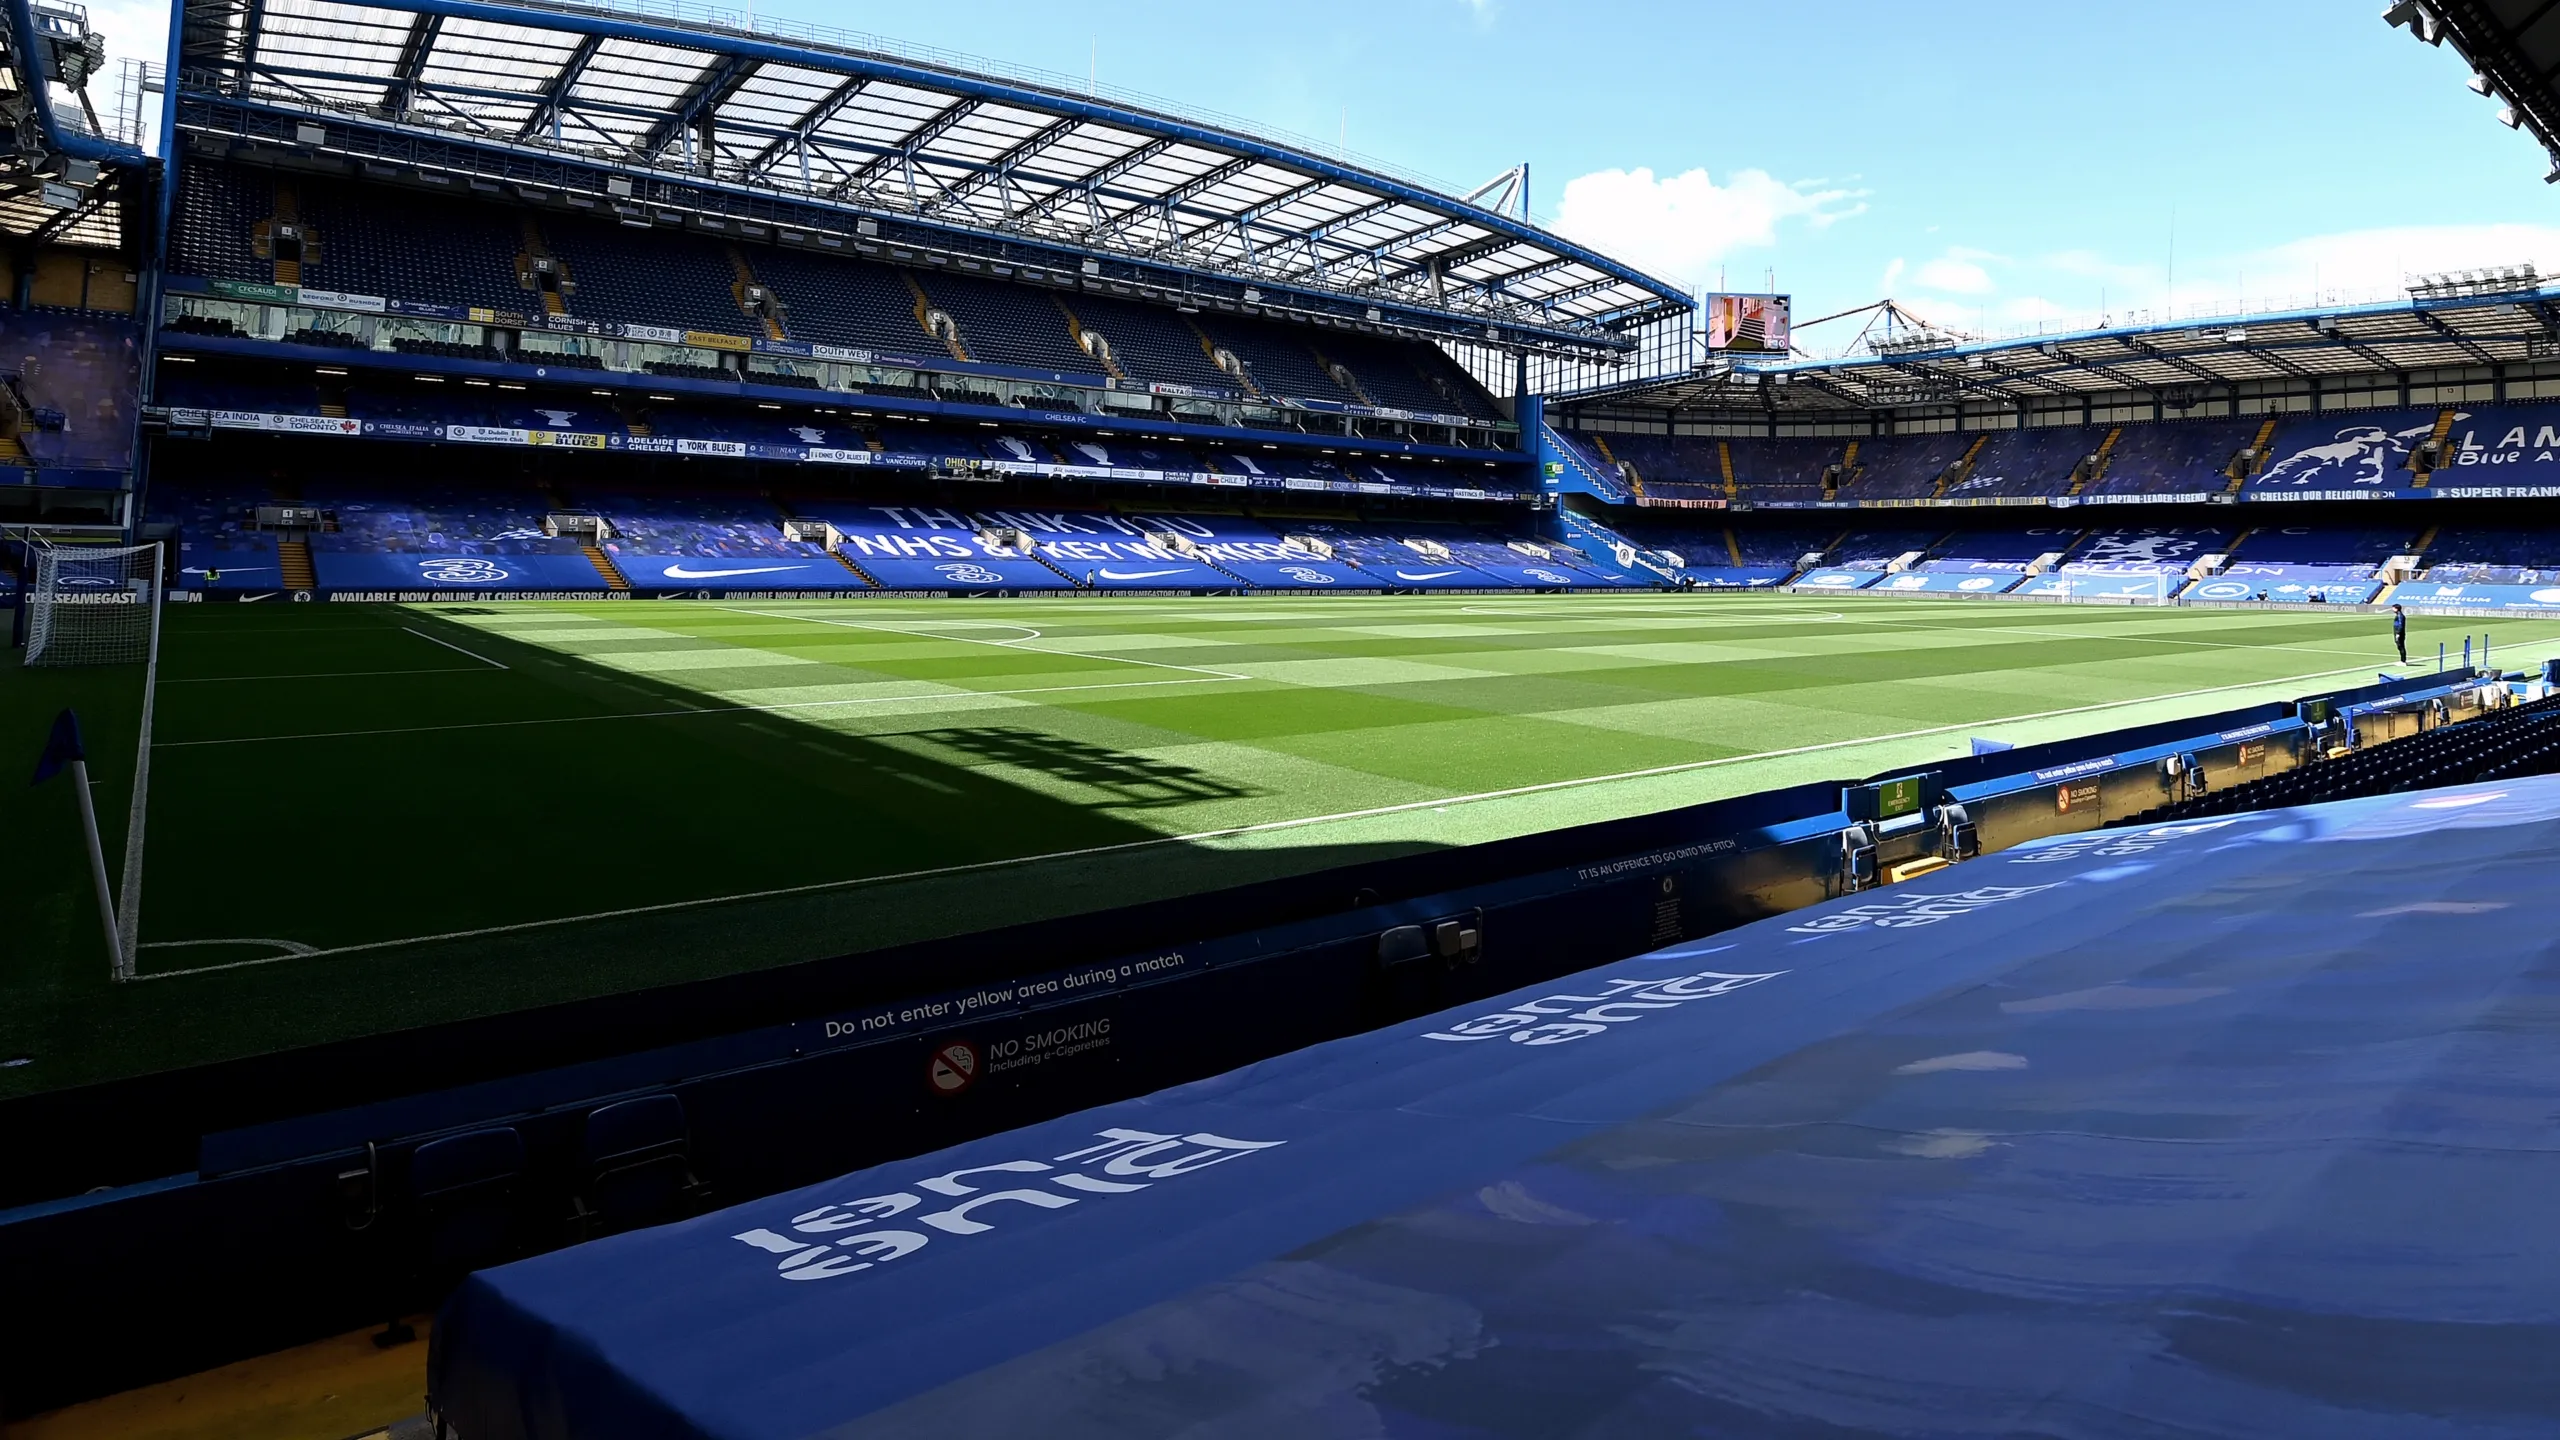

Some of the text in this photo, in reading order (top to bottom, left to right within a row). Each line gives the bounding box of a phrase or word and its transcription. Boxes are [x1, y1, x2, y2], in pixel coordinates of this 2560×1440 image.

[238, 285, 277, 296] CFCSAUDI
[302, 293, 381, 307] BEDFORD RUSHDEN
[495, 310, 524, 319] SOUTH
[494, 317, 527, 327] DORSET
[548, 316, 587, 326] CORNISH
[548, 323, 574, 332] BLUES
[688, 335, 737, 346] EAST BELFAST
[813, 345, 871, 360] SOUTH WEST
[1160, 386, 1184, 396] MALTA
[178, 409, 260, 422] CHELSEA INDIA
[289, 416, 326, 425] CHELSEA
[1044, 413, 1087, 424] CHELSEA FC
[290, 422, 338, 432] TORONTO
[379, 423, 407, 431] CHELSEA
[555, 433, 598, 441] SAFFRON
[626, 436, 674, 446] ADELAIDE
[555, 438, 598, 448] BLUES
[628, 444, 673, 453] CHELSEA
[686, 440, 708, 451] YORK
[712, 442, 736, 453] BLUES
[885, 458, 926, 467] VANCOUVER
[944, 457, 966, 468] OHIO
[2457, 451, 2520, 466] Blue
[1454, 490, 1478, 498] HASTINGS
[2260, 490, 2370, 502] CHELSEA OUR RELIGION
[2450, 487, 2503, 498] SUPER
[1648, 498, 1719, 510] DROGBA LEGEND
[1999, 498, 2034, 506] SATURDAY
[850, 534, 972, 557] NHS
[1042, 541, 1124, 560] KEY
[1114, 542, 1328, 566] WRKERS
[1018, 590, 1191, 598] AVAILABLE NOW ONLINE AT CHELSEAMEGASTORE.COM
[2308, 584, 2366, 594] MSC
[330, 592, 630, 602] AVAILABLE NOW ONLINE AT CHELSEAMEGASTORE.COM
[724, 591, 948, 600] AVAILABLE NOW ONLINE AT CHELSEAMEGASTORE.COM
[2221, 601, 2238, 609] NOW
[2238, 602, 2262, 610] ONLINE
[2262, 602, 2271, 610] AT
[2272, 602, 2357, 614] CHELSEAMEGASTORE.COM
[2036, 772, 2044, 780] Do
[2044, 770, 2052, 778] not
[2052, 768, 2064, 777] enter
[2064, 766, 2075, 776] yellow
[2076, 764, 2084, 772] area
[2102, 759, 2114, 767] match
[2070, 785, 2098, 798] NO SMOKING
[1888, 796, 1910, 807] EMERGENCY
[2093, 819, 2239, 857] Blue
[1578, 838, 1736, 881] IT IS AN OFFENCE TO GO ONTO THE PITCH
[1874, 880, 2068, 928] Blue
[1785, 892, 1968, 933] Fuel
[825, 951, 1185, 1038] Do not enter yellow area during a match
[1420, 978, 1690, 1041] Fuel
[1508, 969, 1794, 1046] Blue
[990, 1018, 1111, 1060] NO SMOKING
[988, 1036, 1111, 1074] Including e-Cigarettes
[730, 1127, 1184, 1254] Fuel
[778, 1133, 1288, 1281] Blue
